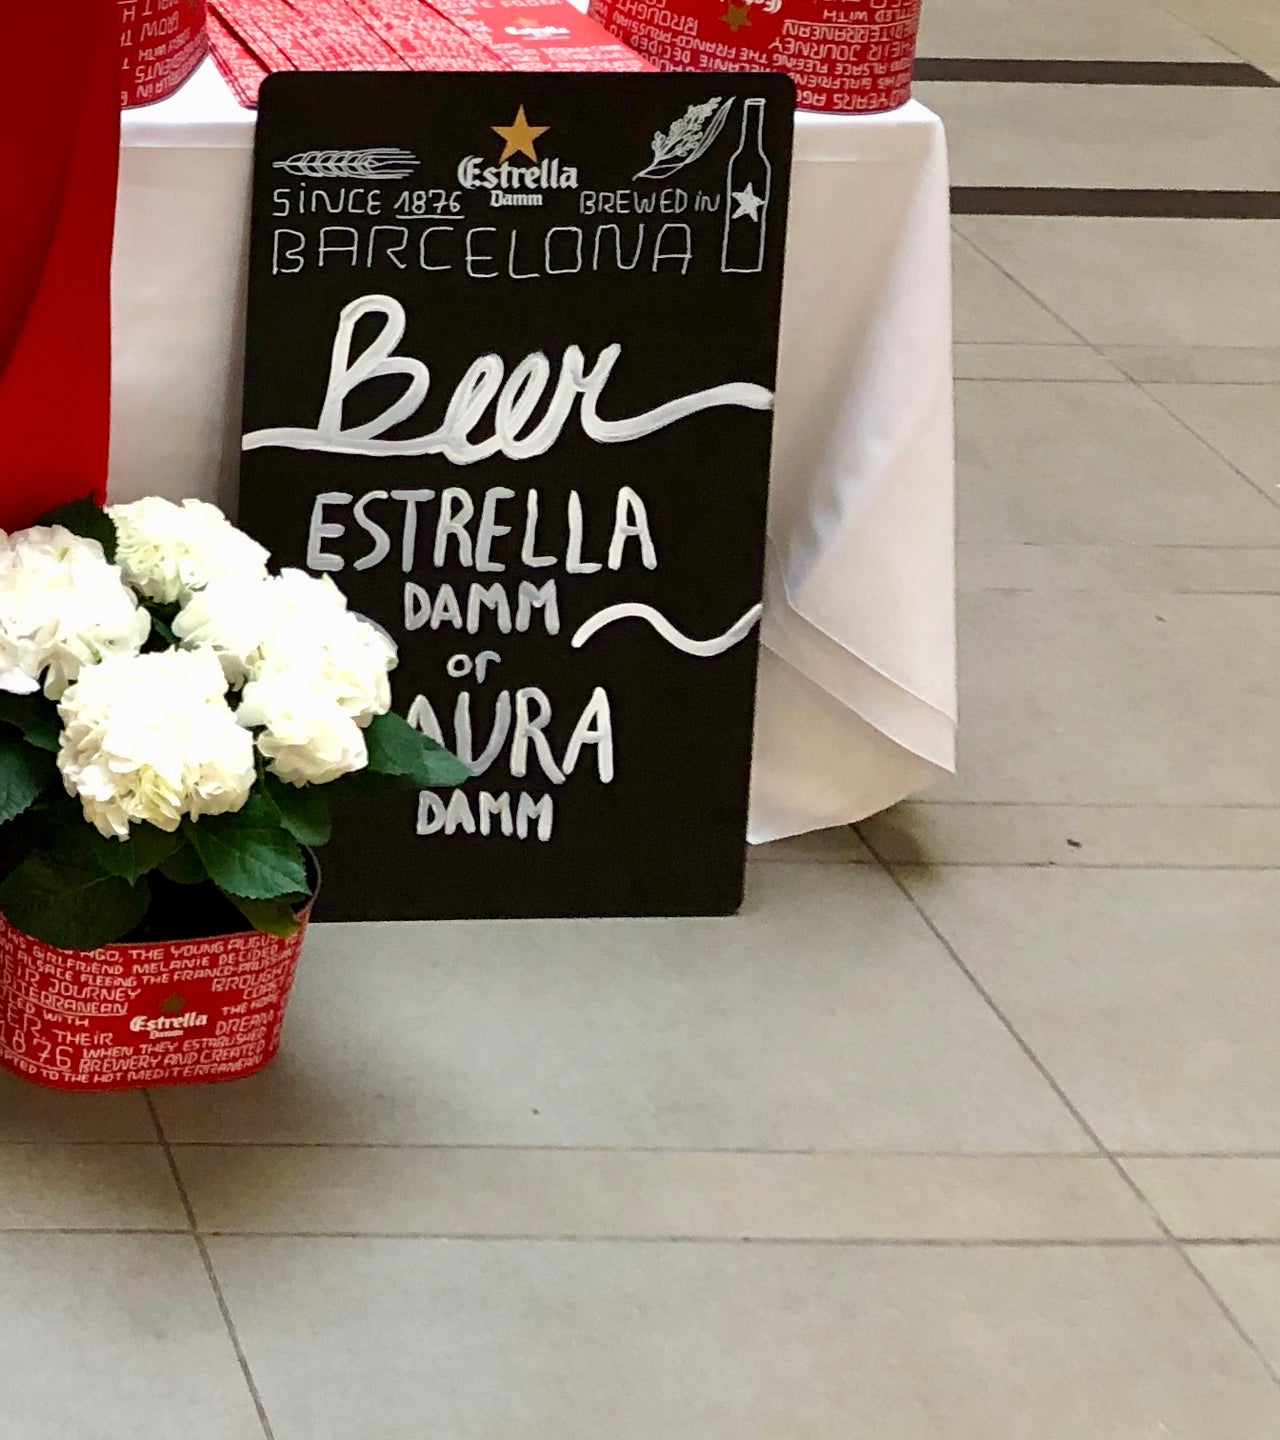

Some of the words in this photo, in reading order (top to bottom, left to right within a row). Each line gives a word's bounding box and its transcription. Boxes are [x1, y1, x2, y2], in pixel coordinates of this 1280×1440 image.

[457, 155, 579, 190] Estrella
[393, 190, 462, 214] 1876
[490, 189, 544, 207] Damm
[580, 189, 689, 214] BREWED
[272, 223, 693, 279] BARCELONA
[306, 486, 657, 574] ESTRELLA
[404, 579, 560, 635] DAMM
[447, 650, 501, 683] or
[407, 687, 614, 784] AURA
[417, 790, 553, 841] DAMM
[48, 978, 141, 1001] JOURNEY
[129, 1011, 208, 1033] Estrella
